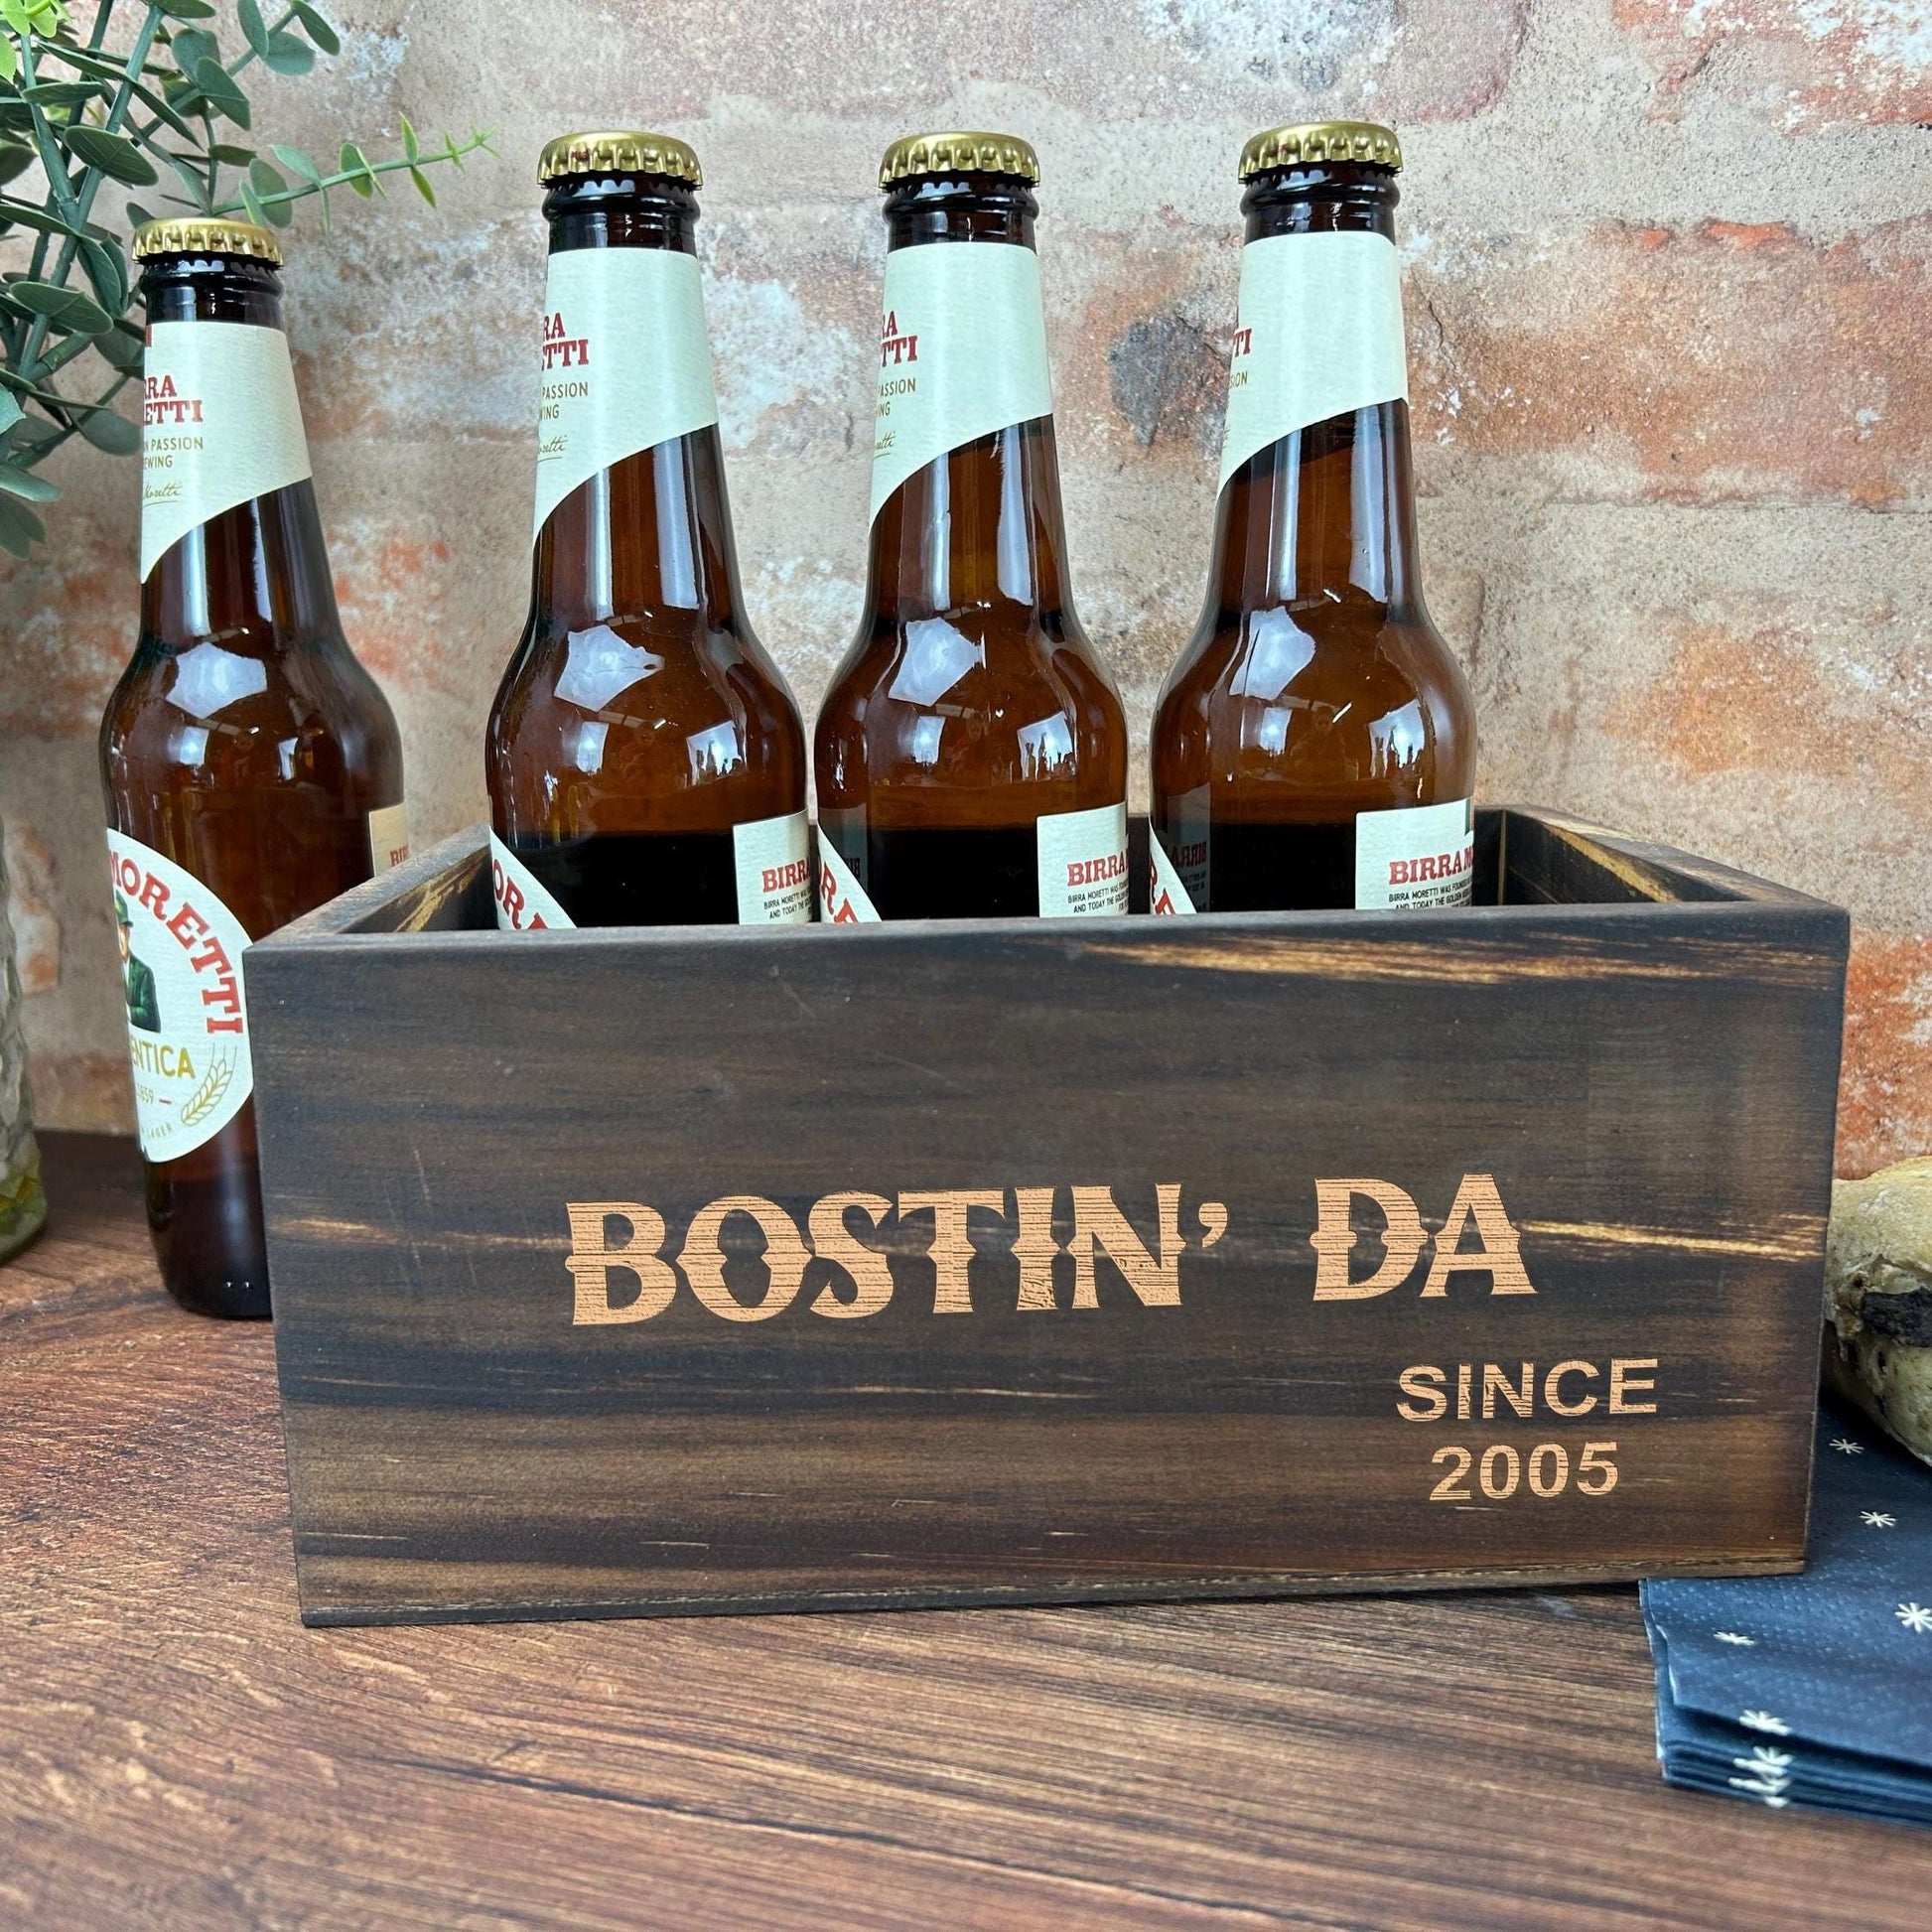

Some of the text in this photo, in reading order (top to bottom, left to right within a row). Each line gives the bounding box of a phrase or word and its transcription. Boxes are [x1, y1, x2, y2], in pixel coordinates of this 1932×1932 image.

[878, 377, 915, 398] ASSION
[151, 437, 204, 452] PASSION
[1067, 851, 1126, 887] BIRRA
[1389, 850, 1462, 885] BIRRA
[1067, 893, 1086, 904] BIRRA
[1389, 892, 1410, 902] BIRRA
[1412, 887, 1439, 899] MORETTI
[769, 908, 781, 919] AND
[1073, 903, 1087, 913] AND
[1088, 899, 1105, 910] TODAY
[564, 1173, 1539, 1326] BOSTIN' DA
[1395, 1357, 1660, 1423] SINCE
[1429, 1441, 1619, 1501] 2005
